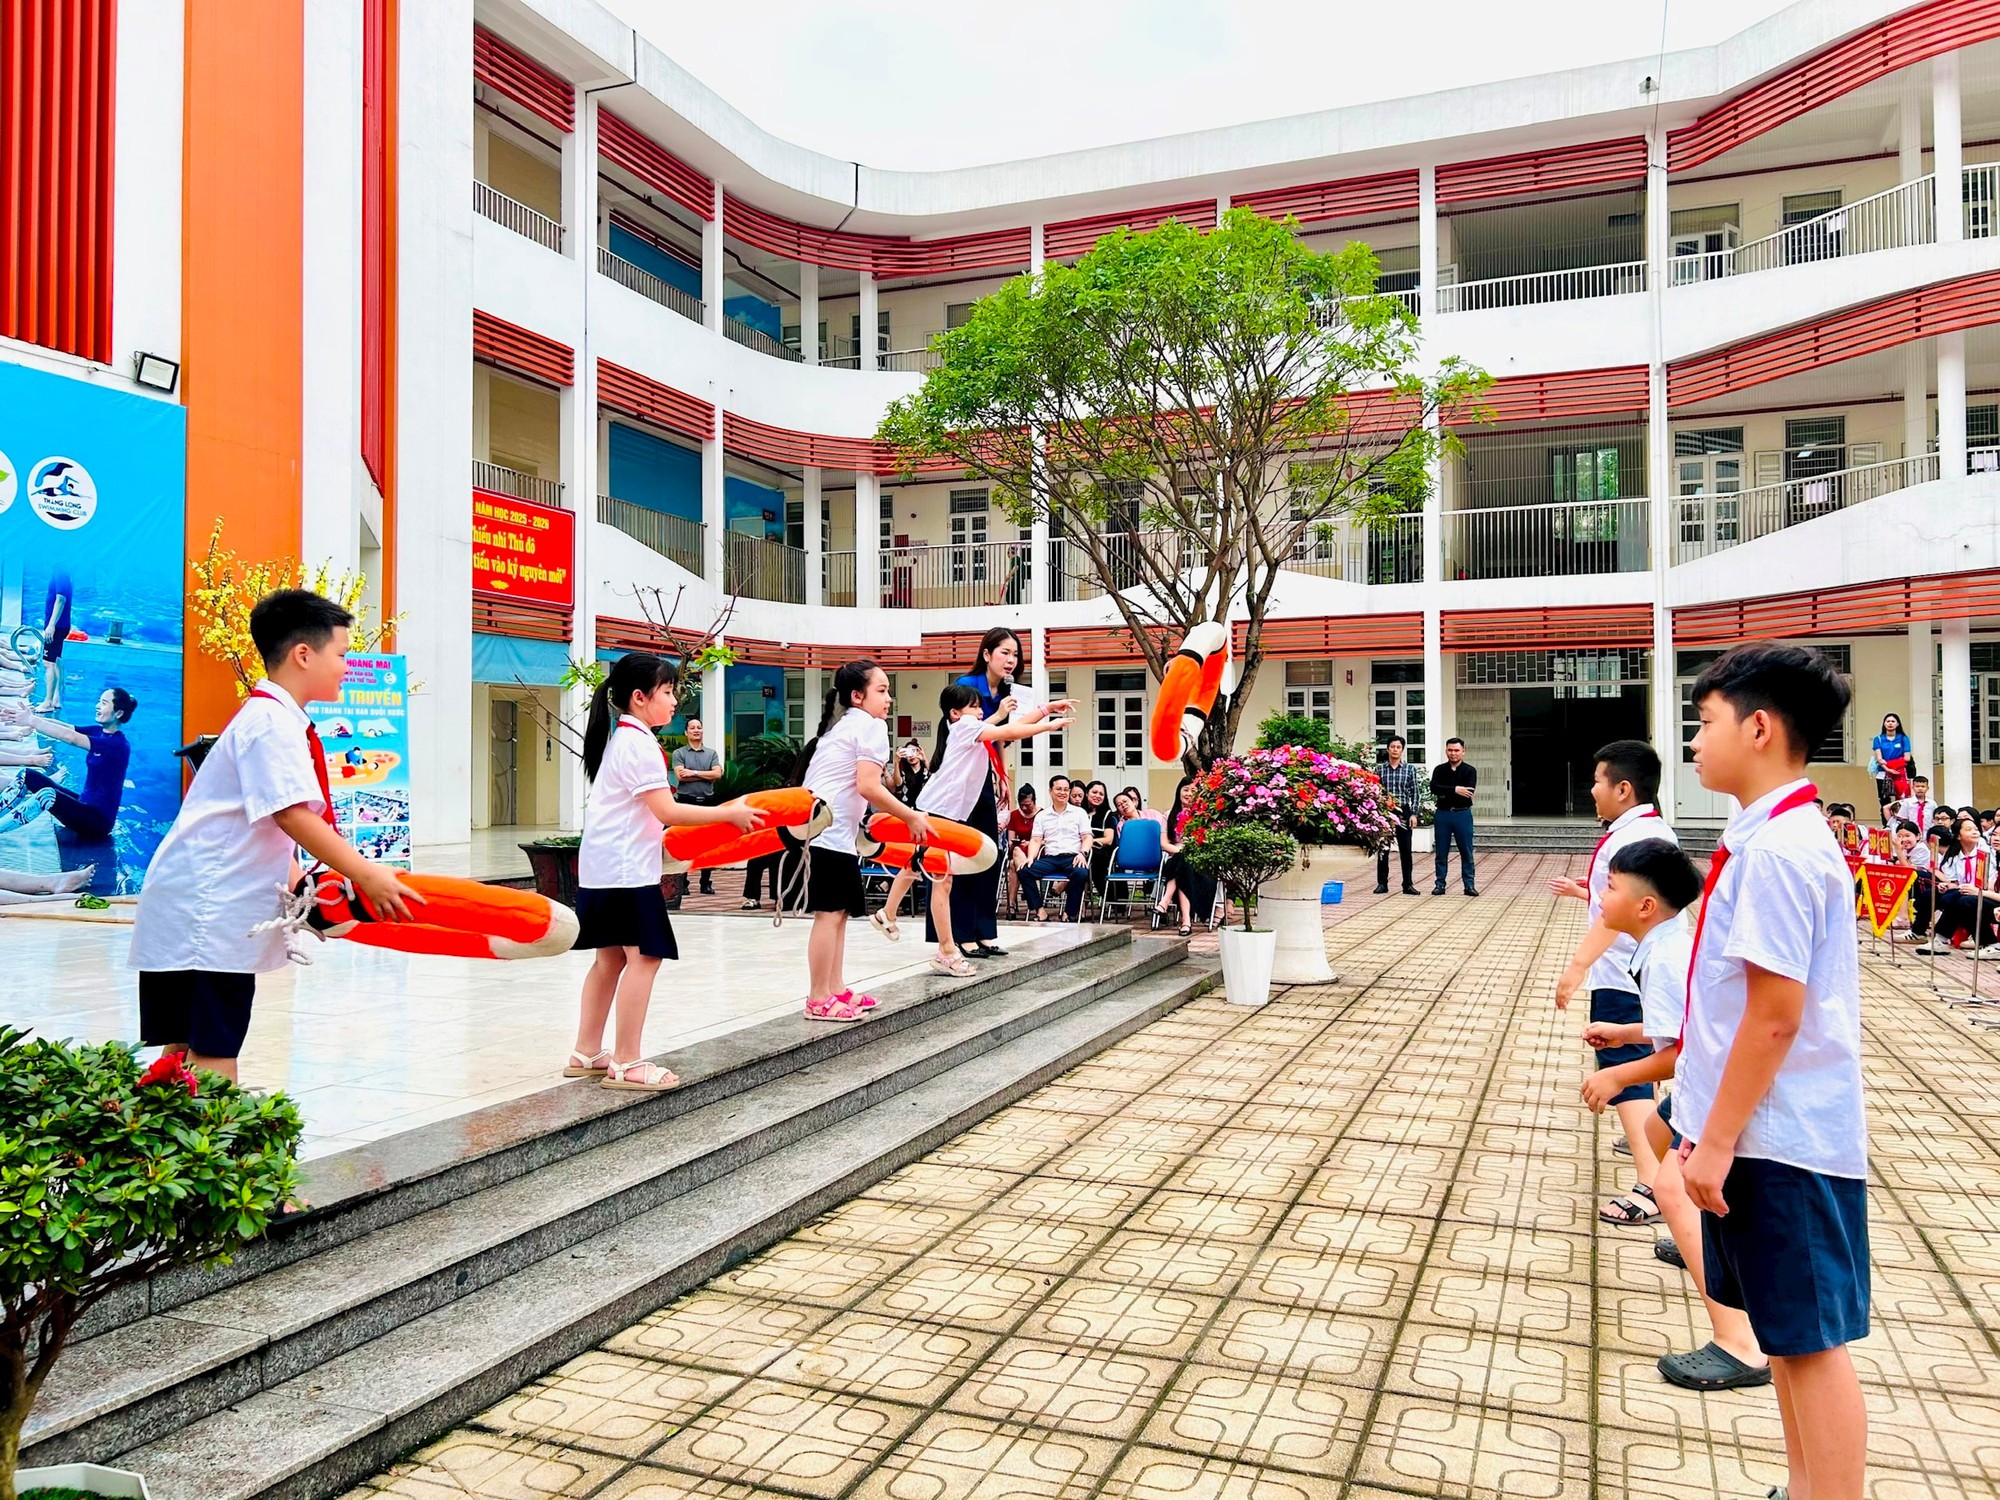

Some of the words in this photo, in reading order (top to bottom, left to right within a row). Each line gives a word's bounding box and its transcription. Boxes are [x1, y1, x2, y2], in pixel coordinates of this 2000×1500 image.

[38, 504, 71, 513] SWIMMING
[475, 501, 492, 516] NĂM
[494, 506, 508, 521] HỌC
[510, 510, 527, 525] 2025
[533, 516, 550, 530] 2026
[473, 524, 491, 545] hiếu
[493, 531, 506, 548] nhi
[508, 532, 524, 552] Thủ
[526, 536, 536, 554] đô
[473, 550, 490, 571] tiến
[491, 555, 506, 573] vào
[507, 558, 518, 579] kỷ
[520, 563, 547, 583] nguyên
[376, 660, 390, 669] MAI
